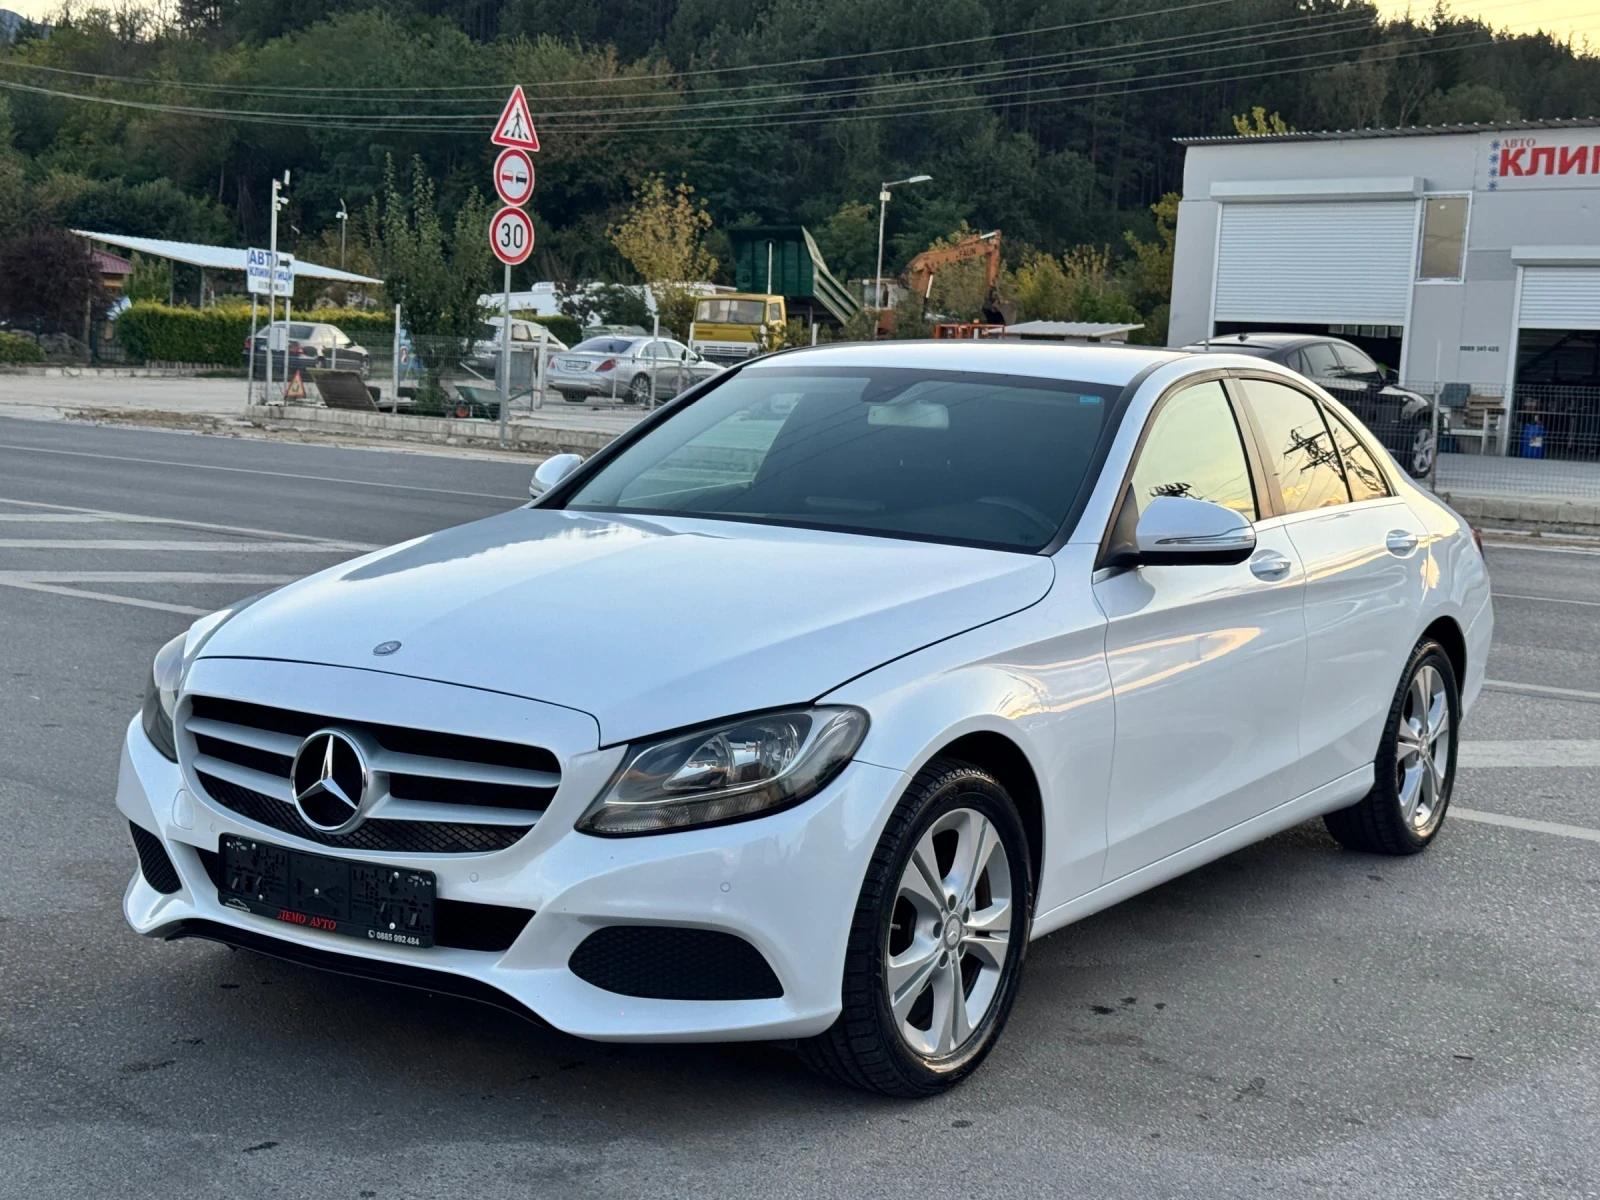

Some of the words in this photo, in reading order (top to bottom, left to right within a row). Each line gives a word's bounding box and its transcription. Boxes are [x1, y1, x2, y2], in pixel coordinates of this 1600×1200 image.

[1503, 138, 1536, 149] АВТО
[1499, 145, 1600, 177] КЛИ
[501, 222, 524, 249] 30
[249, 267, 293, 282] КЛИМТИЦИ
[376, 931, 393, 942] 0885
